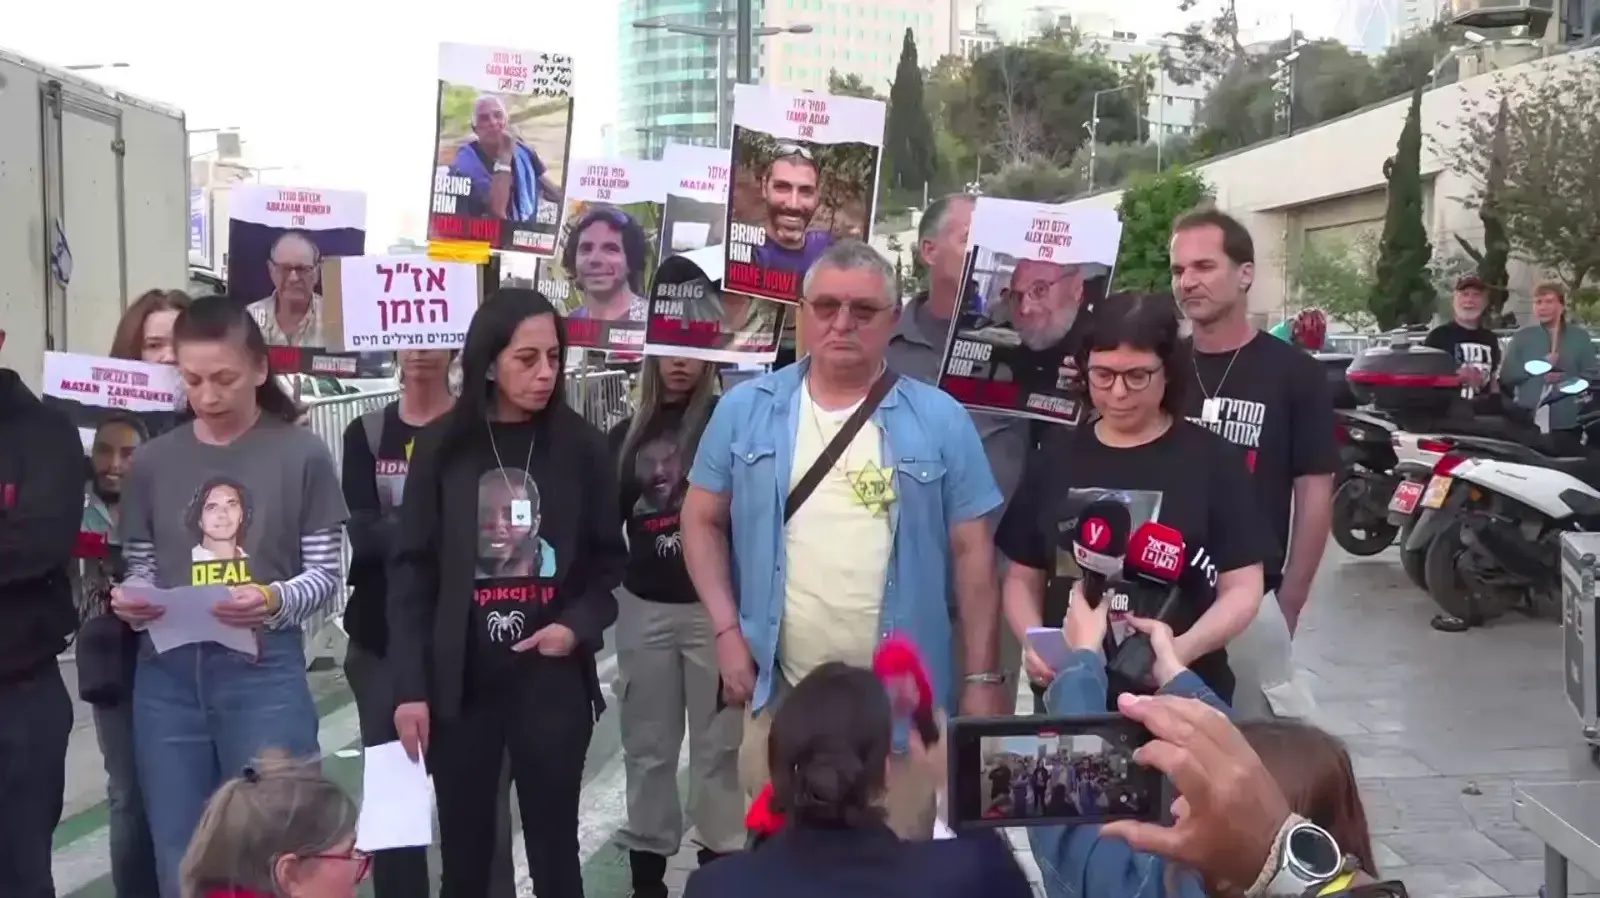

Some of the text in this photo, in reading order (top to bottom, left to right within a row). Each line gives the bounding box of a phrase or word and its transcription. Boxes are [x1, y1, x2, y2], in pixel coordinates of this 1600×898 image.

[486, 64, 528, 78] GADI MOSES
[786, 110, 830, 126] TAMIR ADAR
[434, 176, 472, 196] BRING
[580, 176, 630, 190] OFER KALDERON
[680, 180, 715, 192] MATAN
[266, 202, 331, 214] ABRAHAM MUNDER
[432, 193, 457, 214] HIM
[731, 222, 766, 246] BRING
[1024, 232, 1072, 247] ALEX DANCYG
[730, 241, 752, 264] HIM
[1038, 246, 1054, 258] (75)
[730, 263, 798, 293] HOME NOW!
[538, 280, 570, 299] BRING
[657, 283, 704, 298] BRING
[377, 299, 448, 332] הזמן
[654, 300, 684, 315] HIM
[352, 332, 466, 346] סכמים מצילים חיים
[952, 340, 993, 362] BRING
[947, 357, 974, 376] HIM
[60, 380, 174, 403] MATAN ZANGAUKER
[1214, 396, 1266, 424] מחזירי
[1224, 420, 1262, 448] אותם
[1089, 522, 1104, 546] y
[1147, 536, 1181, 554] ישראל
[1141, 547, 1179, 572] היום
[192, 560, 252, 586] DEAL
